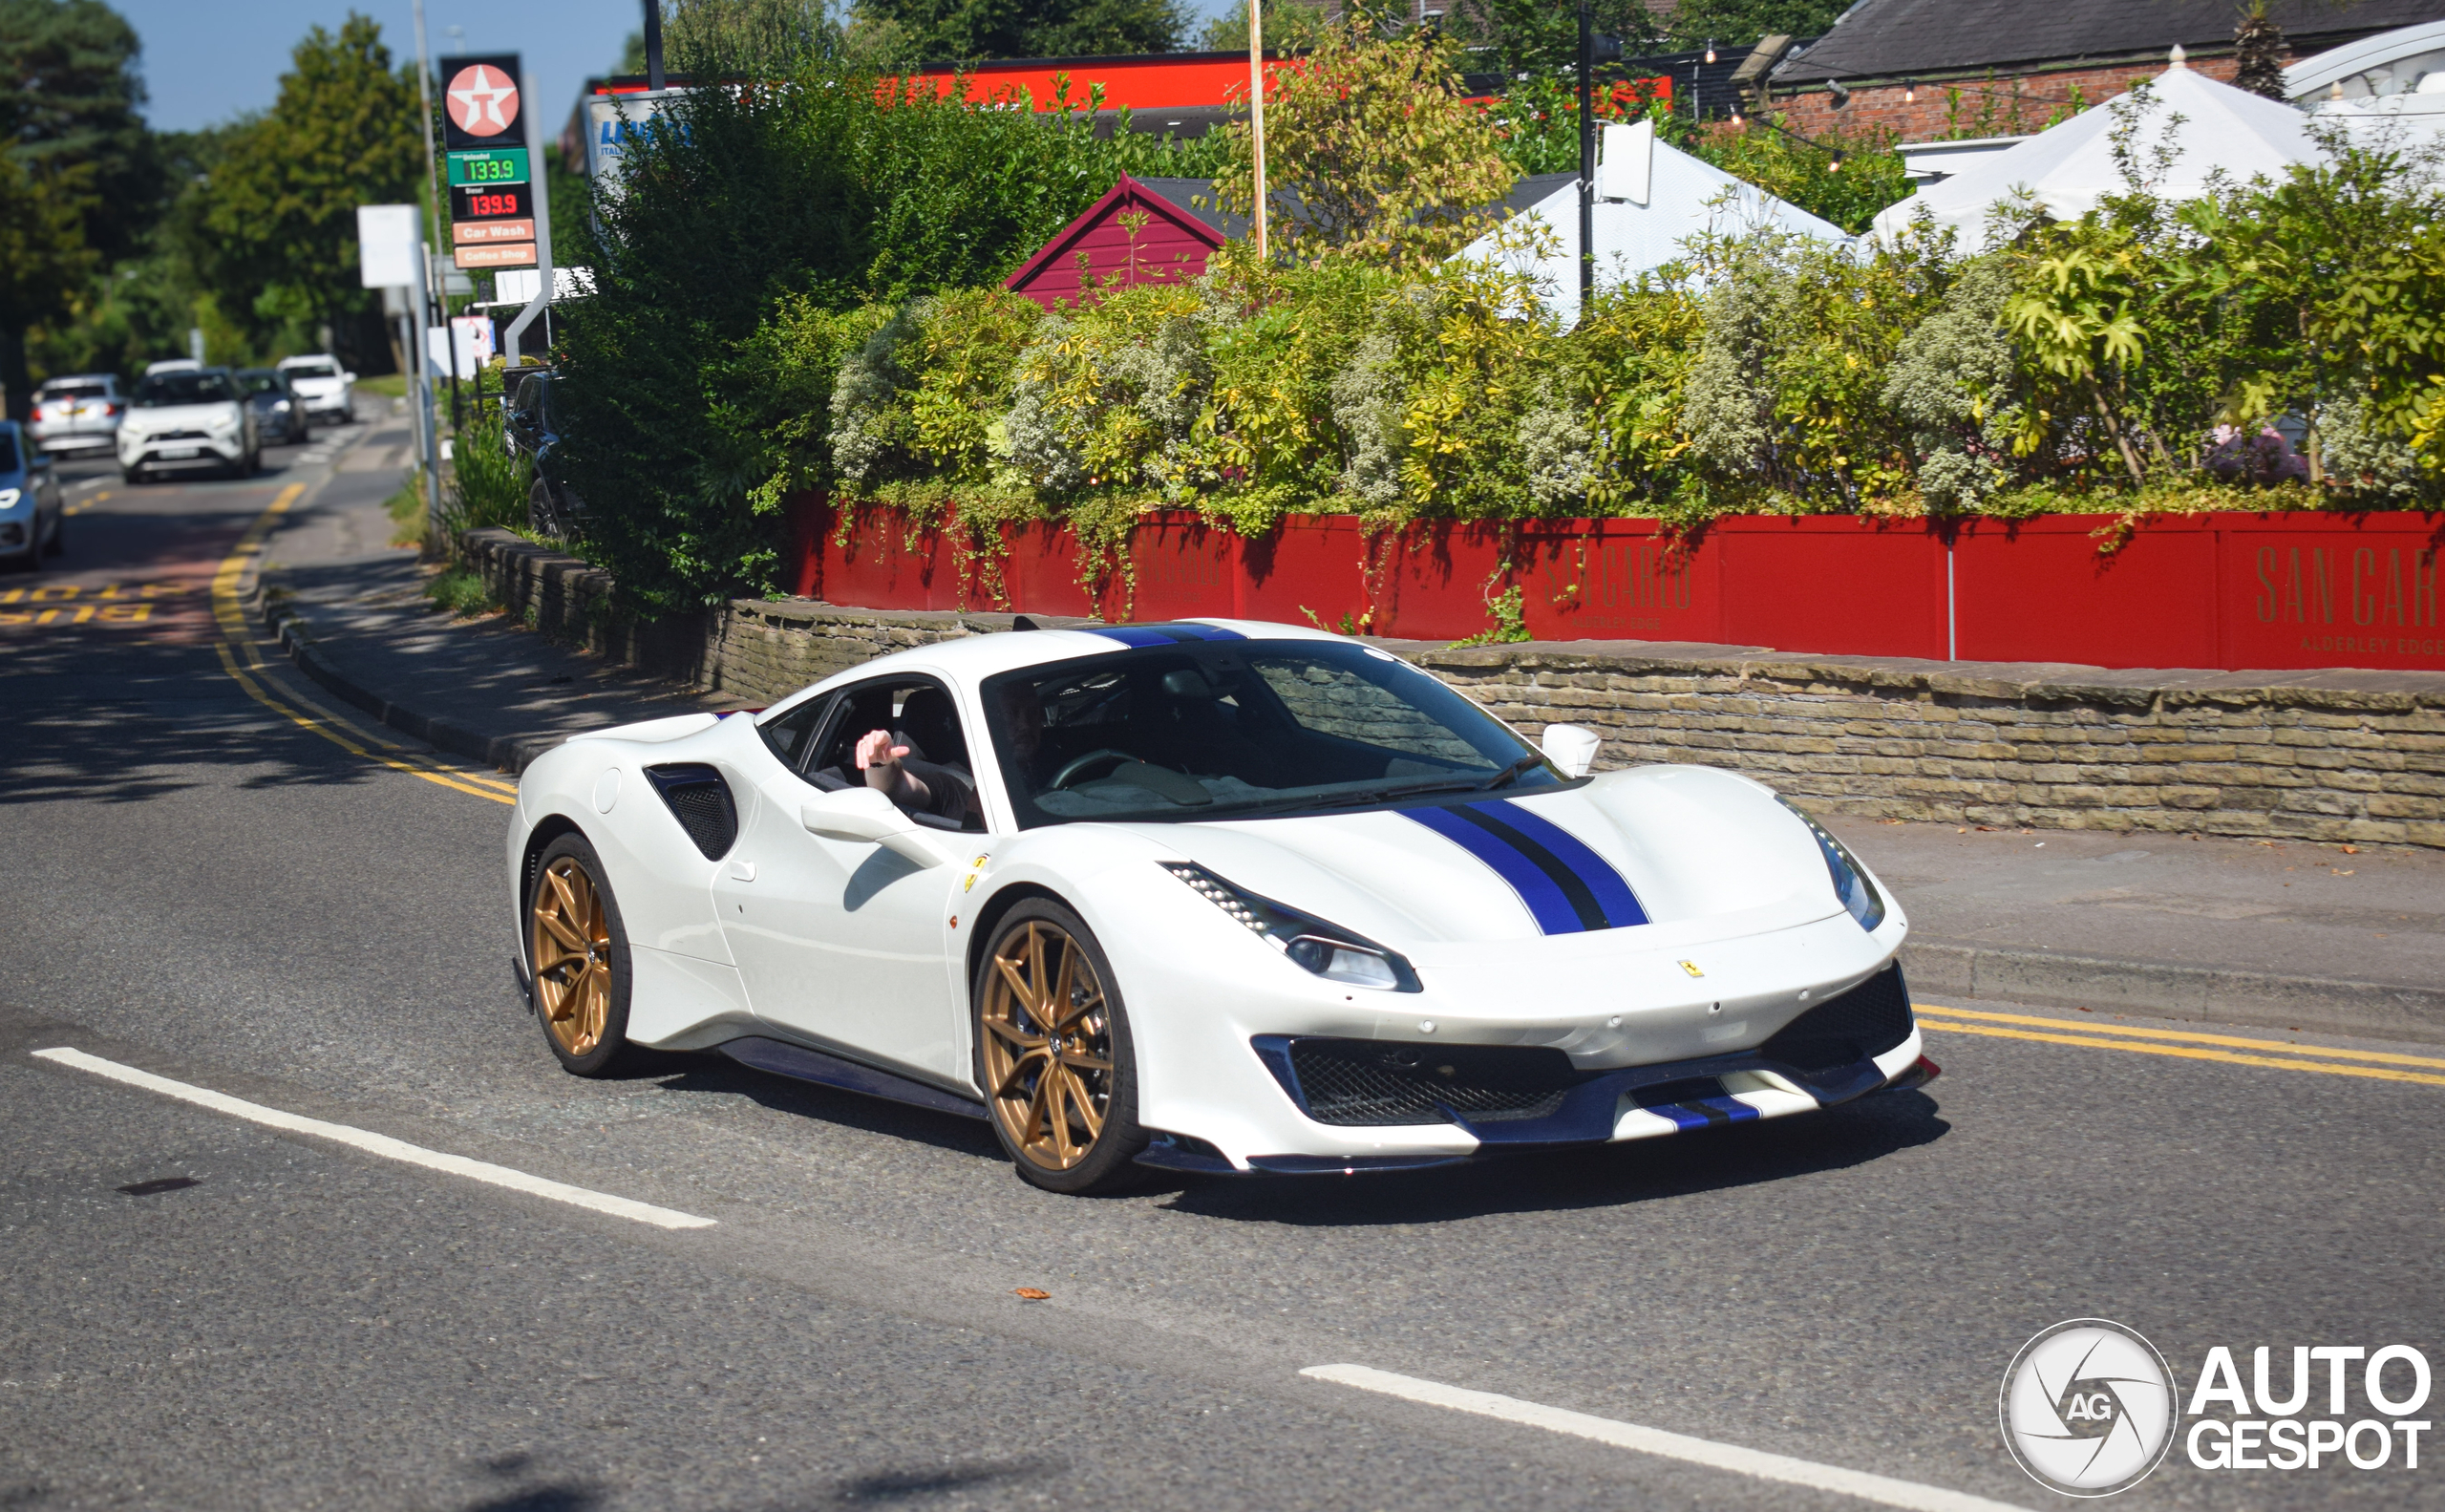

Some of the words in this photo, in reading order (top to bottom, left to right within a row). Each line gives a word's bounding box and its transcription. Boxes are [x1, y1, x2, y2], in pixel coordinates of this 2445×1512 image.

[463, 153, 490, 161] Unleaded
[469, 160, 515, 181] 133.9
[465, 186, 484, 195] Diesel
[472, 194, 518, 215] 139.9
[463, 227, 487, 239] Car
[490, 225, 525, 238] Wash
[465, 252, 499, 262] Coffee
[501, 250, 527, 262] Shop
[1602, 545, 1691, 609] CARLO
[2256, 545, 2335, 625] SAN
[2352, 546, 2438, 627] CAR
[1571, 616, 1626, 629] ALDERLEY
[1630, 617, 1662, 630] EDGE
[2300, 635, 2390, 653] ALDERLEY
[2397, 637, 2445, 656] EDGE
